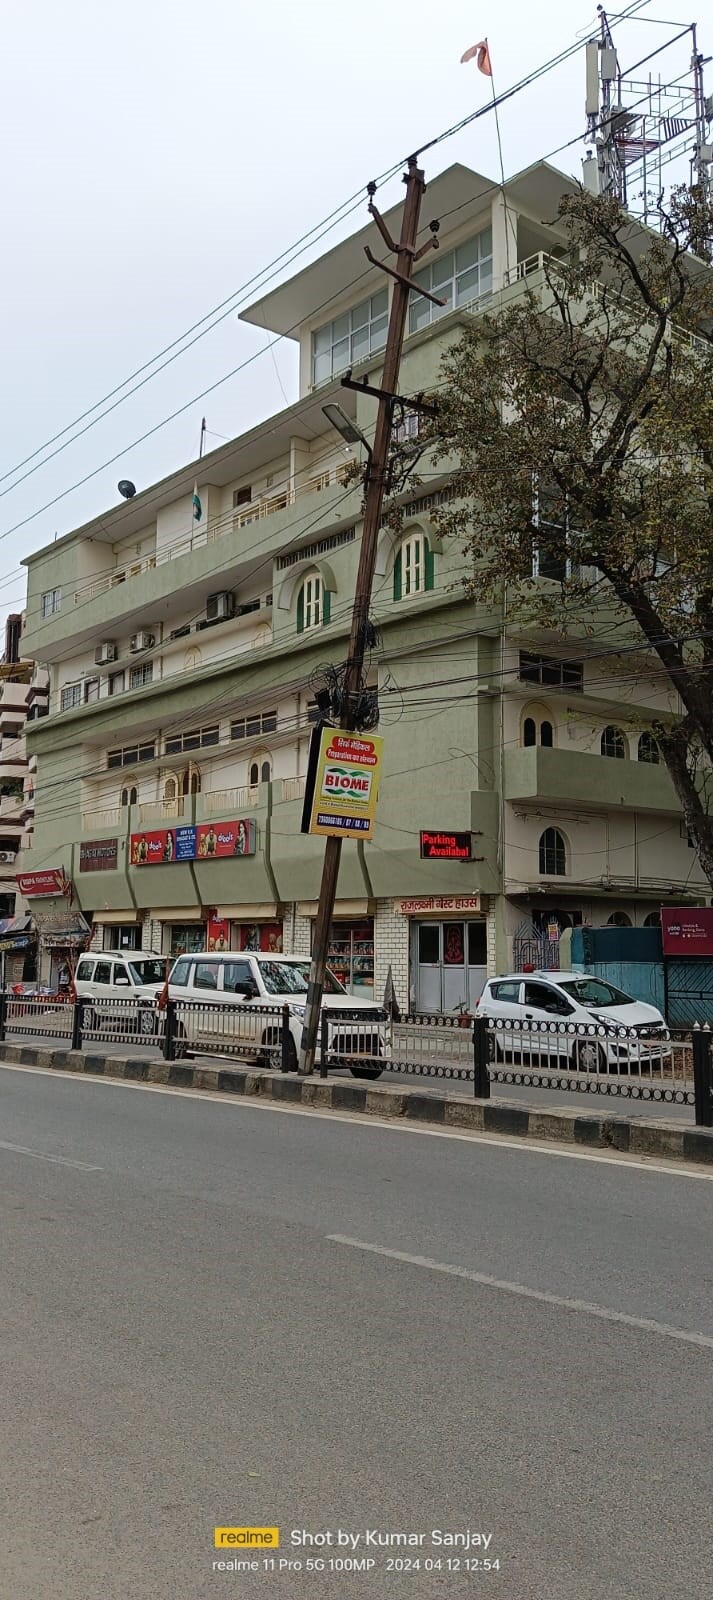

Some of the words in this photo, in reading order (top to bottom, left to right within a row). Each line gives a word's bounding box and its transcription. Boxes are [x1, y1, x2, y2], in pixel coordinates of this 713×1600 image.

[325, 774, 368, 790] BIOME
[423, 833, 456, 847] Parking
[429, 845, 469, 857] Availabal
[436, 897, 454, 909] गेस्ट
[455, 897, 477, 909] हाउस
